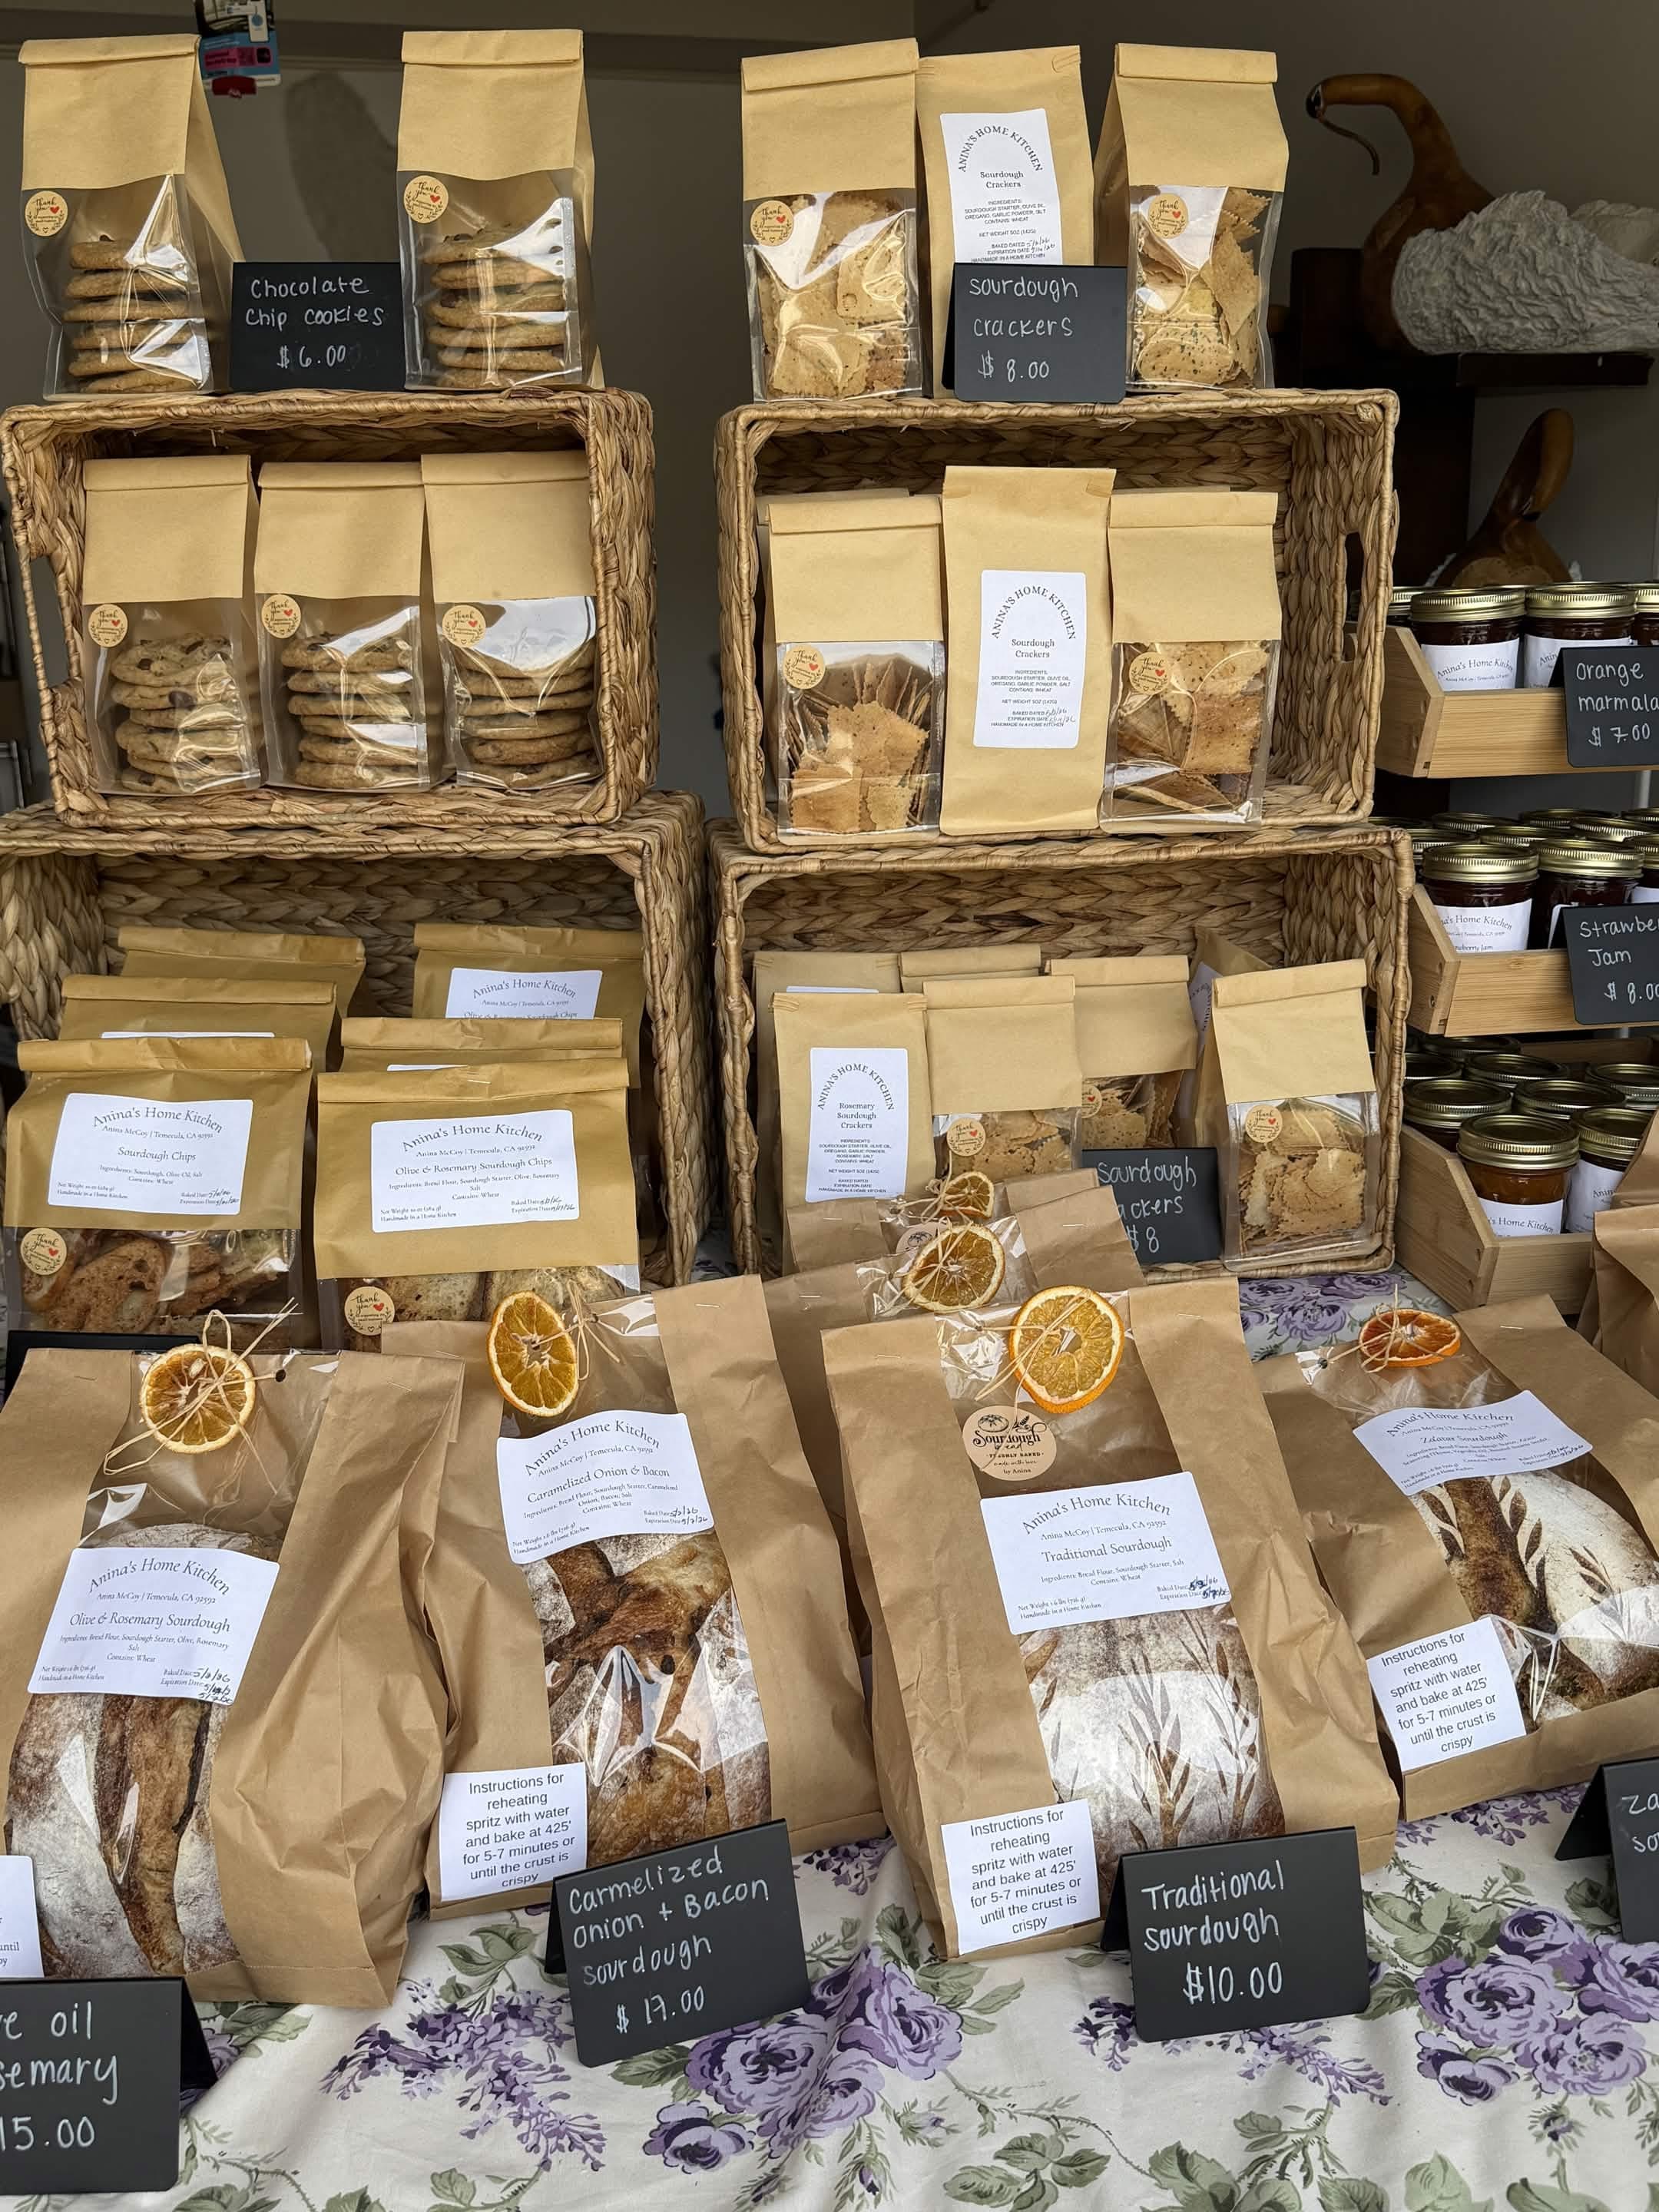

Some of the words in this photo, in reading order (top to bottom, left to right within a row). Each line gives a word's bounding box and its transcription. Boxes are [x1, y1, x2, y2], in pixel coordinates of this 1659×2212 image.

[959, 135, 977, 172] ANINA'S
[975, 125, 1009, 137] HOME
[1010, 132, 1043, 171] KITCHEN
[980, 171, 1024, 180] Sourdough
[251, 276, 369, 298] Chocolate
[992, 597, 1015, 639] ANINA'S
[1015, 586, 1048, 599] HOME
[1049, 594, 1075, 639] KITCHEN
[1012, 639, 1055, 647] Sourdough
[1469, 660, 1492, 668] Home
[1484, 916, 1512, 930] Kitchen
[473, 981, 509, 998] Anina's
[513, 979, 541, 988] Home
[543, 980, 576, 998] Kitchen
[817, 1074, 839, 1110] ANINA'S
[837, 1064, 867, 1075] HOME
[869, 1070, 894, 1110] KITCHEN
[94, 1106, 140, 1128] Anina's
[145, 1107, 181, 1120] Home
[185, 1111, 223, 1133] Kitchen
[837, 1112, 876, 1121] Sourdough
[402, 1128, 449, 1152] Anina's
[452, 1124, 490, 1135] Home
[495, 1124, 543, 1142] Kitchen
[118, 1146, 168, 1161] Sourdough
[171, 1151, 197, 1163] Chips
[396, 1166, 421, 1175] Olive
[434, 1164, 477, 1174] Rosemary
[479, 1160, 525, 1170] Sourdough
[528, 1157, 552, 1167] Chips
[1499, 1217, 1525, 1227] Home
[1528, 1220, 1553, 1233] Kitchen
[1386, 1413, 1423, 1436] Anina's
[1457, 1432, 1508, 1441] Sourdough
[525, 1439, 568, 1476] Anina's
[571, 1422, 611, 1442] Home
[615, 1420, 660, 1449] Kitchen
[528, 1472, 591, 1504] Caramelized
[594, 1466, 628, 1479] Onion
[643, 1465, 670, 1477] Bacon
[1022, 1502, 1068, 1535] Anina's
[1071, 1495, 1111, 1511] Home
[1117, 1494, 1171, 1515] Kitchen
[1041, 1544, 1108, 1562] Traditional
[1110, 1536, 1172, 1554] Sourdough
[88, 1561, 136, 1593] Anina's
[141, 1558, 180, 1573] Home
[183, 1561, 230, 1596] Kitchen
[70, 1613, 96, 1626] Olive
[110, 1613, 163, 1629] Rosemary
[166, 1614, 230, 1634] Sourdough
[1382, 1638, 1448, 1667] Instructions
[1450, 1632, 1465, 1644] for
[1403, 1652, 1458, 1676] reheating
[1390, 1681, 1422, 1698] spritz
[1424, 1672, 1448, 1687] with
[1450, 1662, 1482, 1679] water
[1396, 1698, 1418, 1713] and
[1420, 1690, 1449, 1707] bake
[1452, 1686, 1463, 1695] at
[1399, 1717, 1414, 1730] for
[1417, 1710, 1435, 1724] 5-7
[1439, 1698, 1482, 1718] minutes
[1485, 1694, 1496, 1704] or
[1410, 1727, 1434, 1744] until
[1436, 1725, 1454, 1737] the
[1456, 1714, 1484, 1731] crust
[1485, 1712, 1496, 1721] is
[1441, 1736, 1474, 1752] crispy
[469, 1777, 543, 1794] Instructions
[547, 1773, 564, 1784] for
[488, 1793, 548, 1810] reheating
[466, 1816, 501, 1832] spritz
[505, 1812, 531, 1825] with
[535, 1806, 569, 1820] water
[971, 1814, 1043, 1836] Instructions
[1048, 1810, 1064, 1823] for
[463, 1854, 480, 1865] for
[484, 1849, 505, 1861] 5-7
[509, 1840, 558, 1857] minutes
[562, 1836, 575, 1846] or
[465, 1834, 490, 1847] and
[494, 1830, 525, 1843] bake
[529, 1828, 541, 1837] at
[991, 1832, 1050, 1852] reheating
[470, 1866, 496, 1879] until
[501, 1863, 520, 1874] the
[524, 1855, 555, 1869] crust
[558, 1853, 568, 1862] is
[972, 1859, 1005, 1875] spritz
[1009, 1852, 1035, 1866] with
[1038, 1845, 1074, 1860] water
[502, 1874, 538, 1887] crispy
[972, 1876, 995, 1890] and
[1000, 1871, 1031, 1885] bake
[1035, 1869, 1047, 1879] at
[1141, 1859, 1284, 1910] Traditional
[659, 1902, 672, 1921] +
[685, 1879, 769, 1919] Bacon
[971, 1896, 986, 1909] for
[991, 1889, 1011, 1903] 5-7
[1015, 1881, 1065, 1898] minutes
[1069, 1877, 1081, 1887] or
[981, 1908, 1005, 1925] until
[1008, 1905, 1028, 1916] the
[1031, 1896, 1063, 1912] crust
[1066, 1894, 1077, 1904] is
[1012, 1917, 1048, 1934] crispy
[1183, 1962, 1283, 2005] $10.00
[51, 2001, 91, 2039] oil
